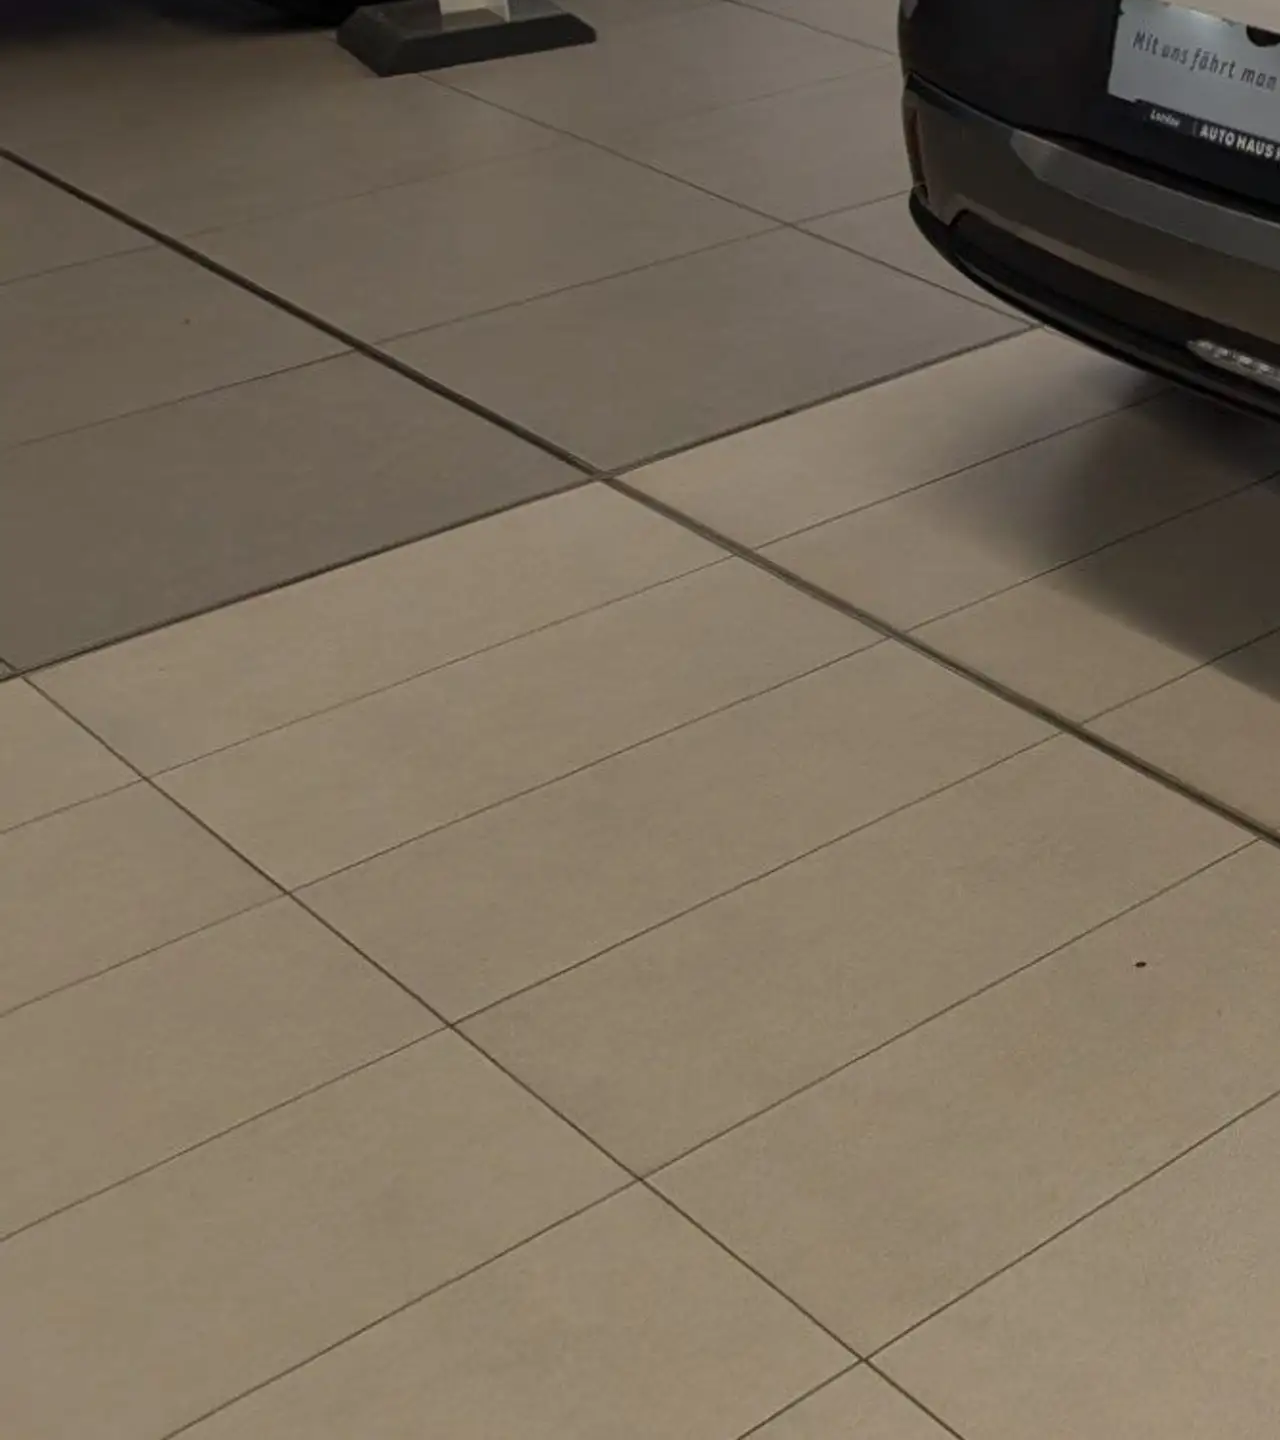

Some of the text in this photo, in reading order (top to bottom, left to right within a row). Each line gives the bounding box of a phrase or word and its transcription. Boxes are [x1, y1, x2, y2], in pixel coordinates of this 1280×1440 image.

[1132, 30, 1160, 56] Mit
[1161, 41, 1189, 65] uns
[1189, 47, 1237, 80] fährt
[1240, 67, 1277, 92] man
[1199, 127, 1235, 147] AUTO
[1236, 135, 1274, 159] HAUS
